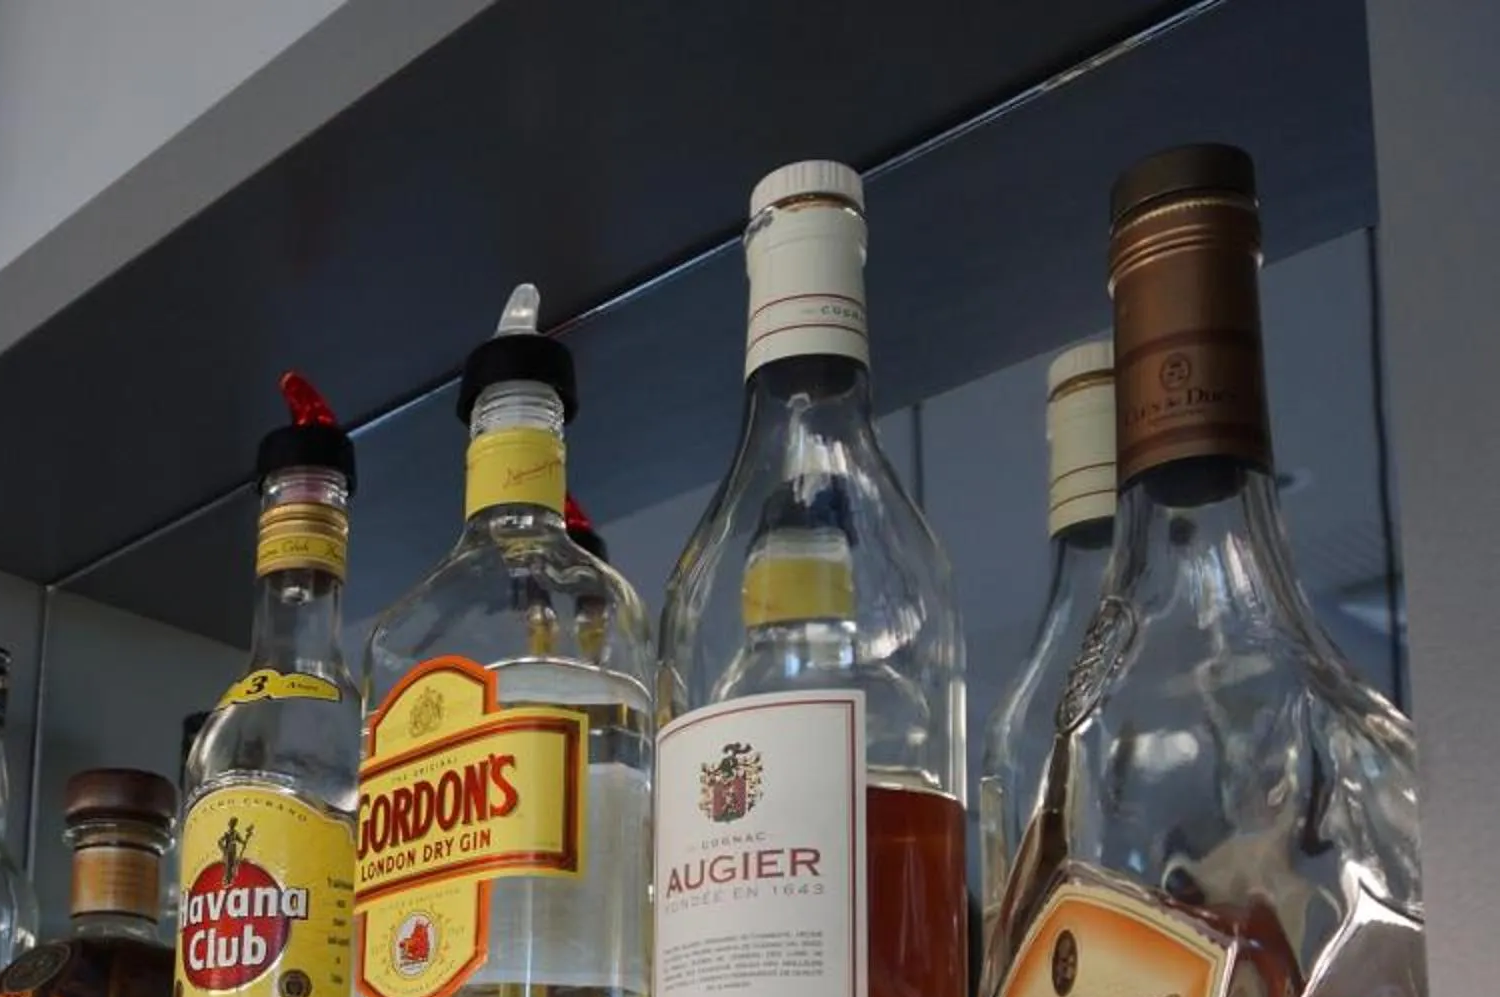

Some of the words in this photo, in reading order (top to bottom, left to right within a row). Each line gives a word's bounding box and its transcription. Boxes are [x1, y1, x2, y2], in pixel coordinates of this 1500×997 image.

[246, 675, 269, 695] 3
[356, 752, 520, 862] GORDON'S
[361, 846, 416, 883] LONDON
[422, 838, 455, 864] DRY
[459, 828, 492, 853] GIN
[701, 831, 767, 850] COGNAC
[666, 847, 821, 899] AUGIER
[772, 882, 826, 896] 1643
[189, 923, 268, 972] Club
